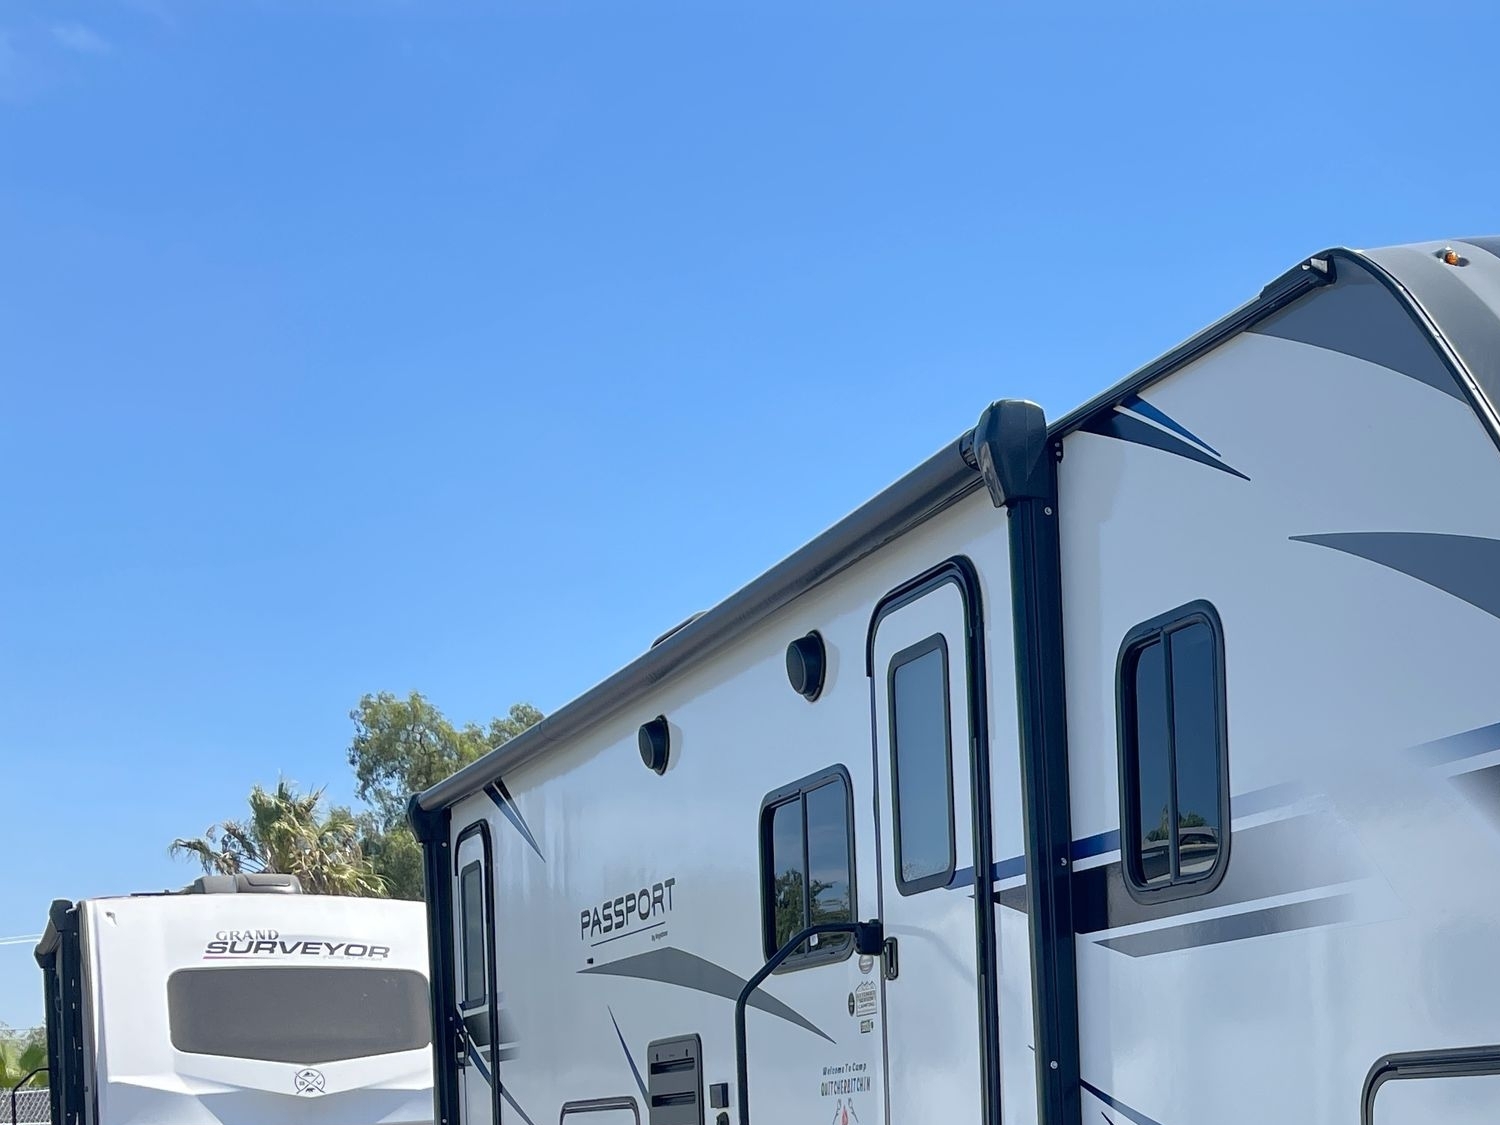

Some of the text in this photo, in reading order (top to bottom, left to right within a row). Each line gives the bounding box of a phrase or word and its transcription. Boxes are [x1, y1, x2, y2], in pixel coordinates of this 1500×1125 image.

[580, 877, 676, 941] PASSPORT
[215, 929, 280, 942] GRAND
[205, 940, 391, 958] SURVEYOR
